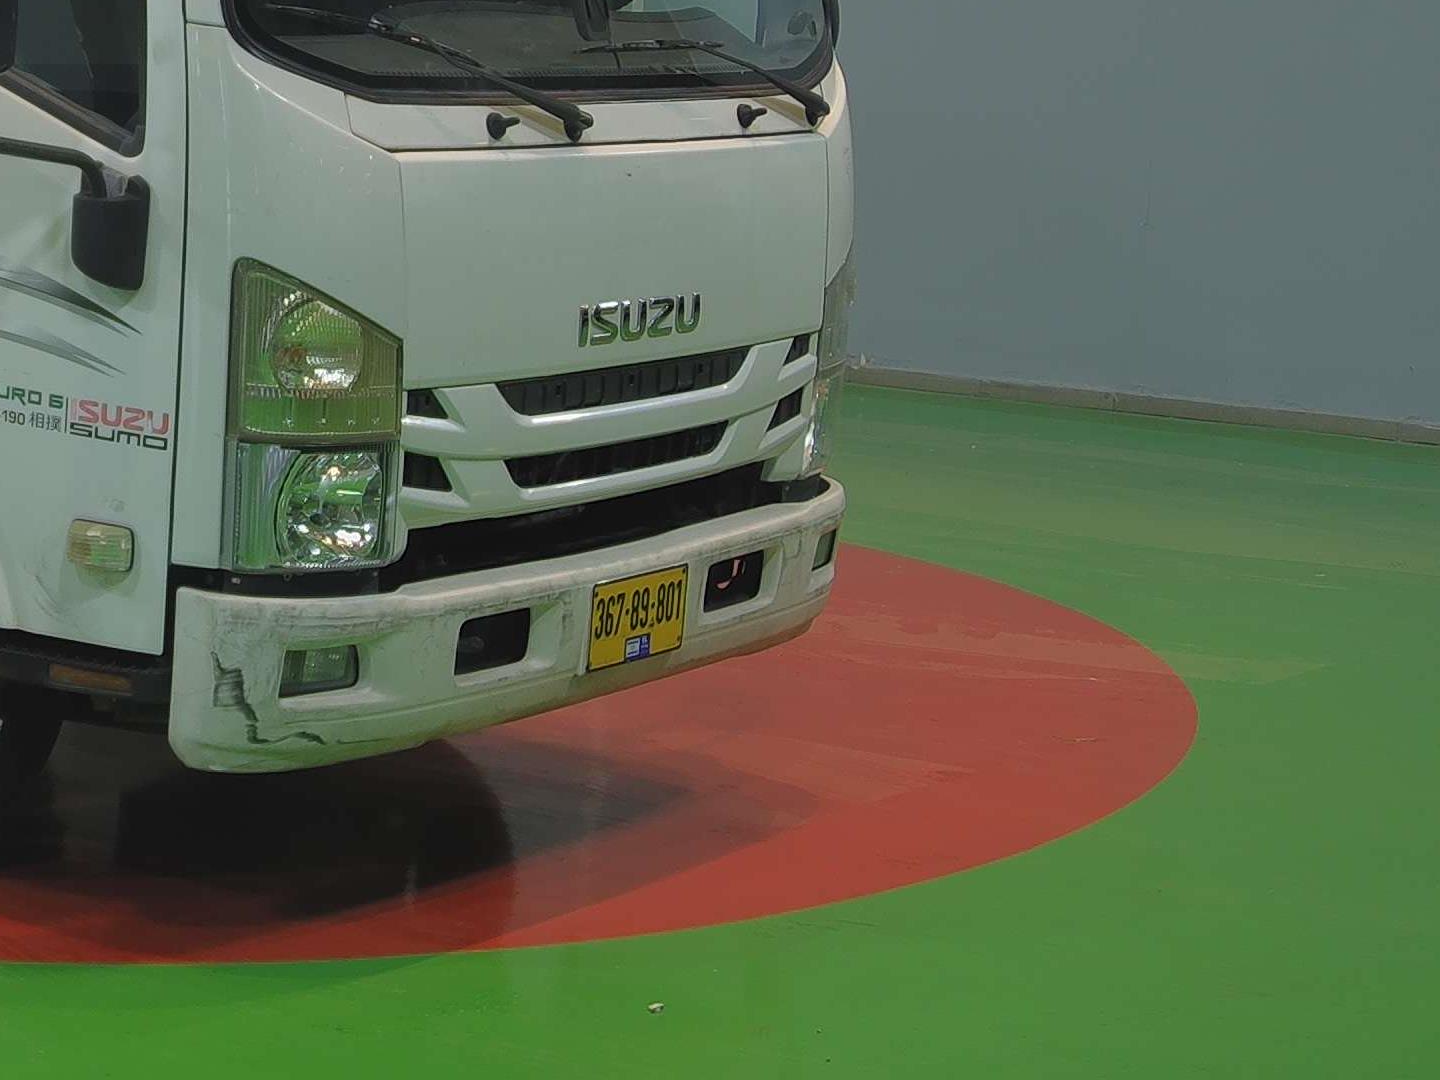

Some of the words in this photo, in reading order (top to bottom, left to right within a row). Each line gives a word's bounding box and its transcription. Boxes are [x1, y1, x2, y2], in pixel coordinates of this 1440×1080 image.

[578, 293, 701, 347] ISUZU
[48, 393, 64, 409] 6
[69, 422, 168, 451] SUMO
